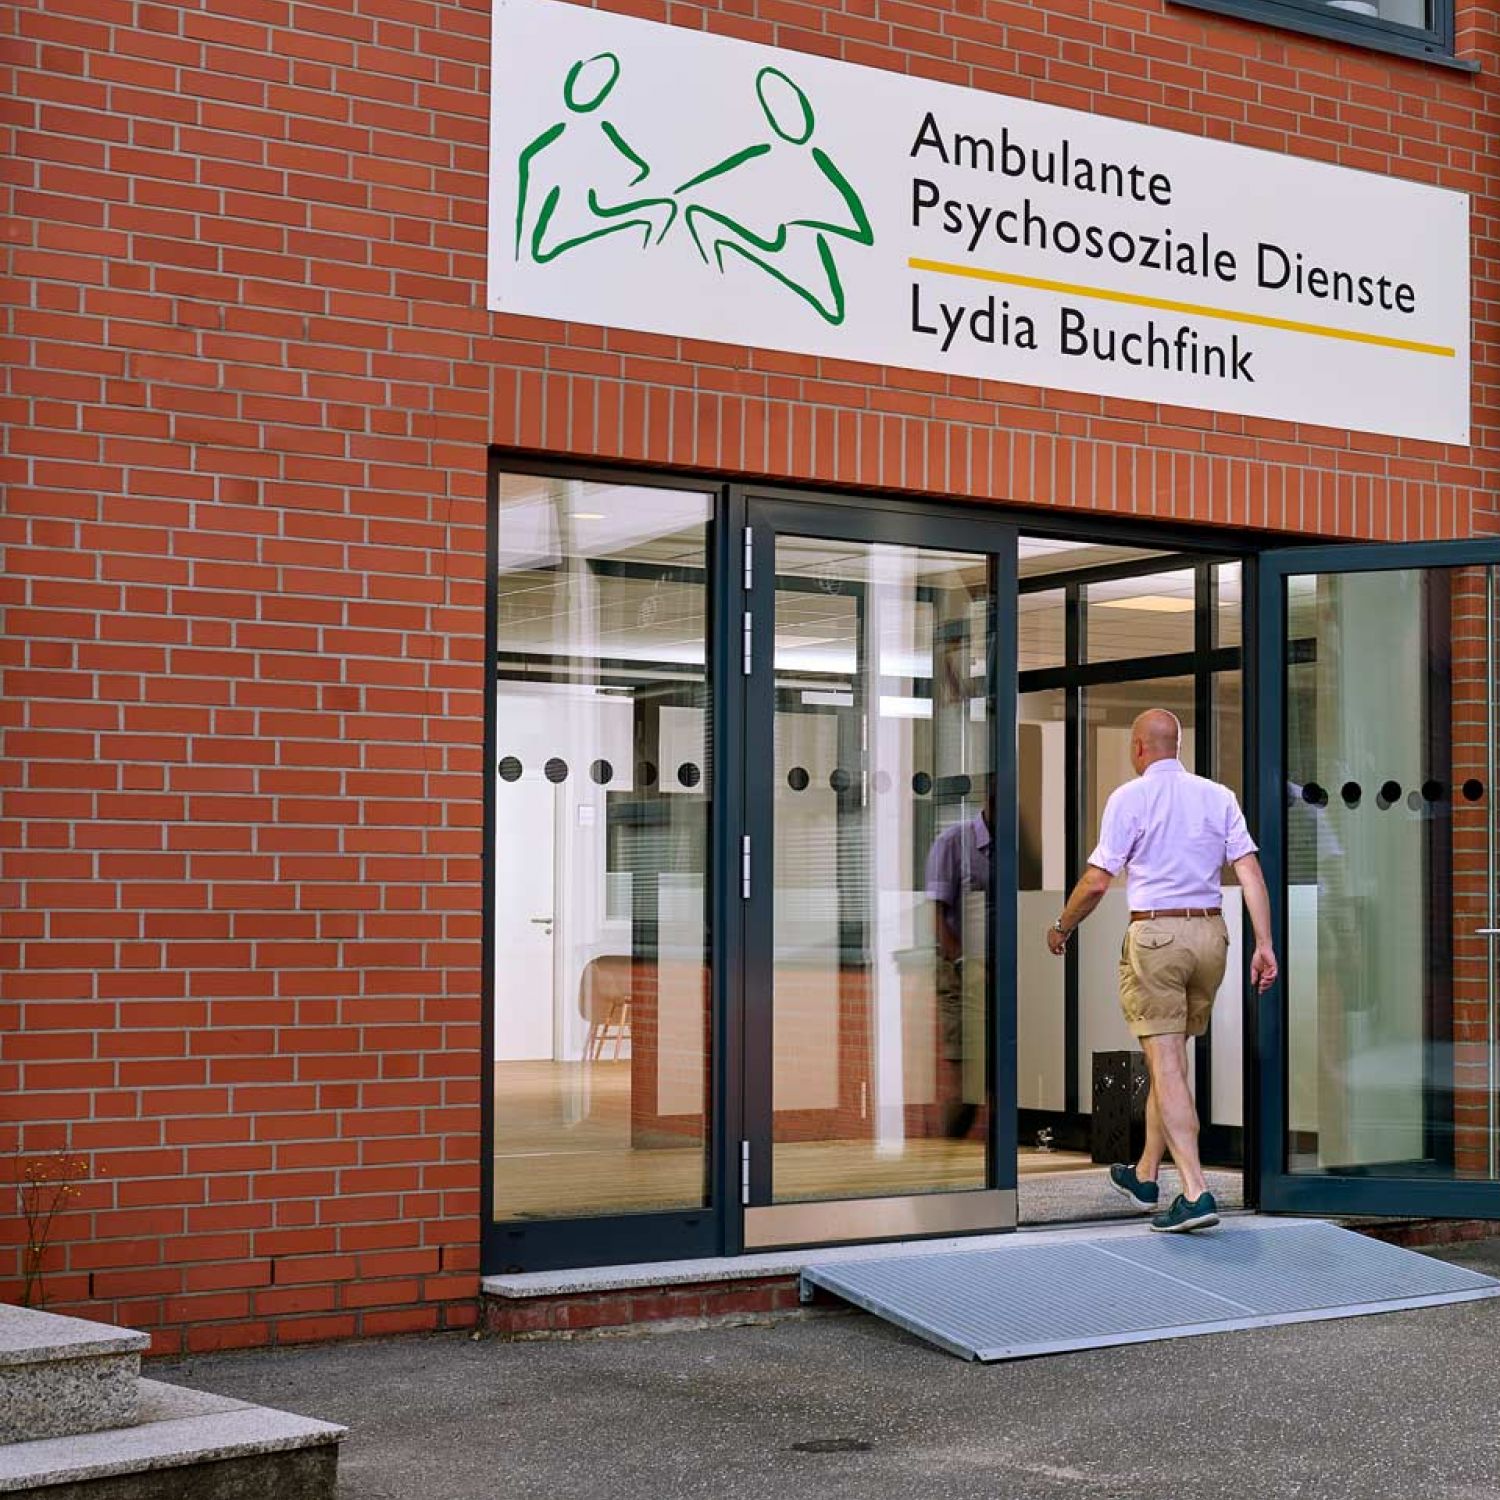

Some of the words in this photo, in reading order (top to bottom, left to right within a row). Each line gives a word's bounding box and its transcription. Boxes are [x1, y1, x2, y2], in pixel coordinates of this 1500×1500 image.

[910, 111, 1172, 206] Ambulante
[912, 177, 1237, 282] Psychosoziale
[1257, 242, 1415, 314] Dienste
[911, 283, 1038, 355] Lydia
[1060, 306, 1255, 383] Buchfink
